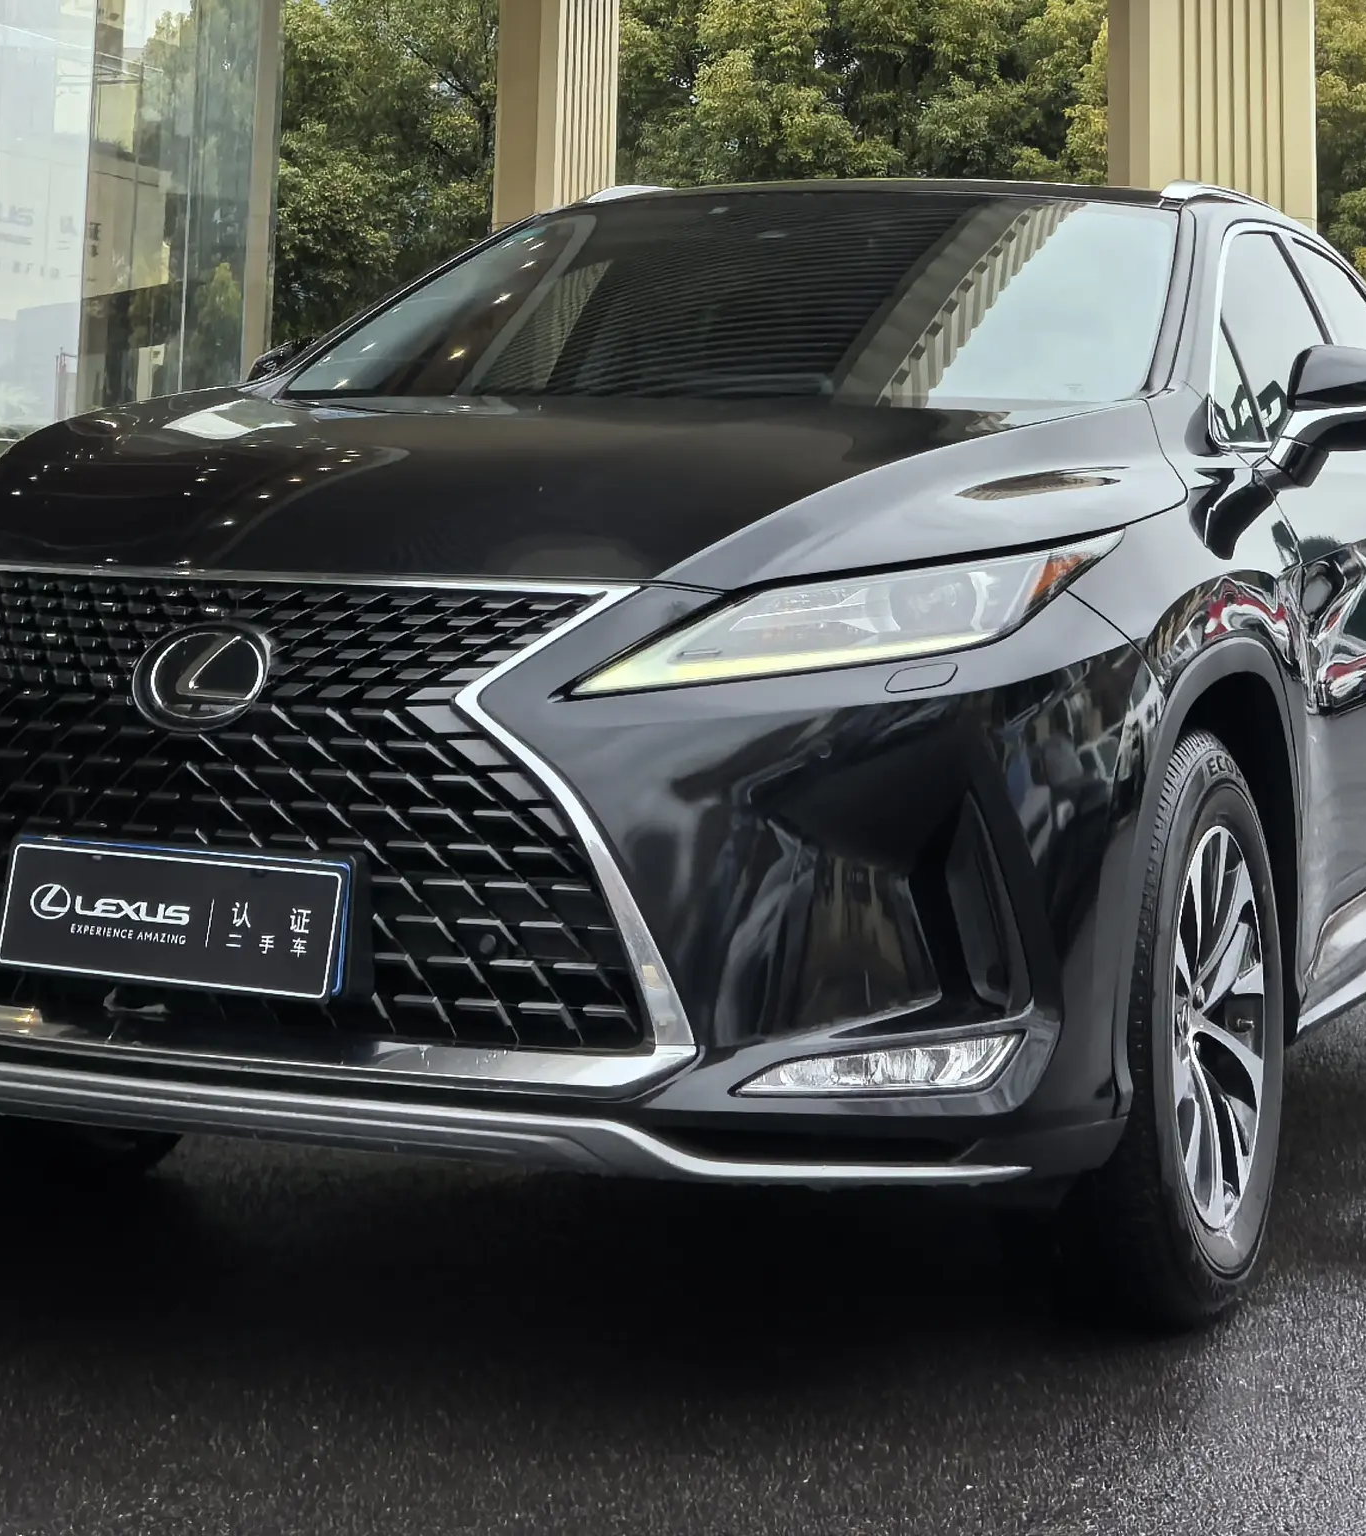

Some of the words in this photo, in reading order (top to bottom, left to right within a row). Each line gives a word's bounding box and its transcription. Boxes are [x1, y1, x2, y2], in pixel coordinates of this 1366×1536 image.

[75, 895, 191, 925] LEXUS
[231, 901, 313, 934] 认证
[70, 923, 134, 941] EXPERIENCE
[136, 930, 187, 945] AMAZING
[225, 933, 308, 958] 二手车
